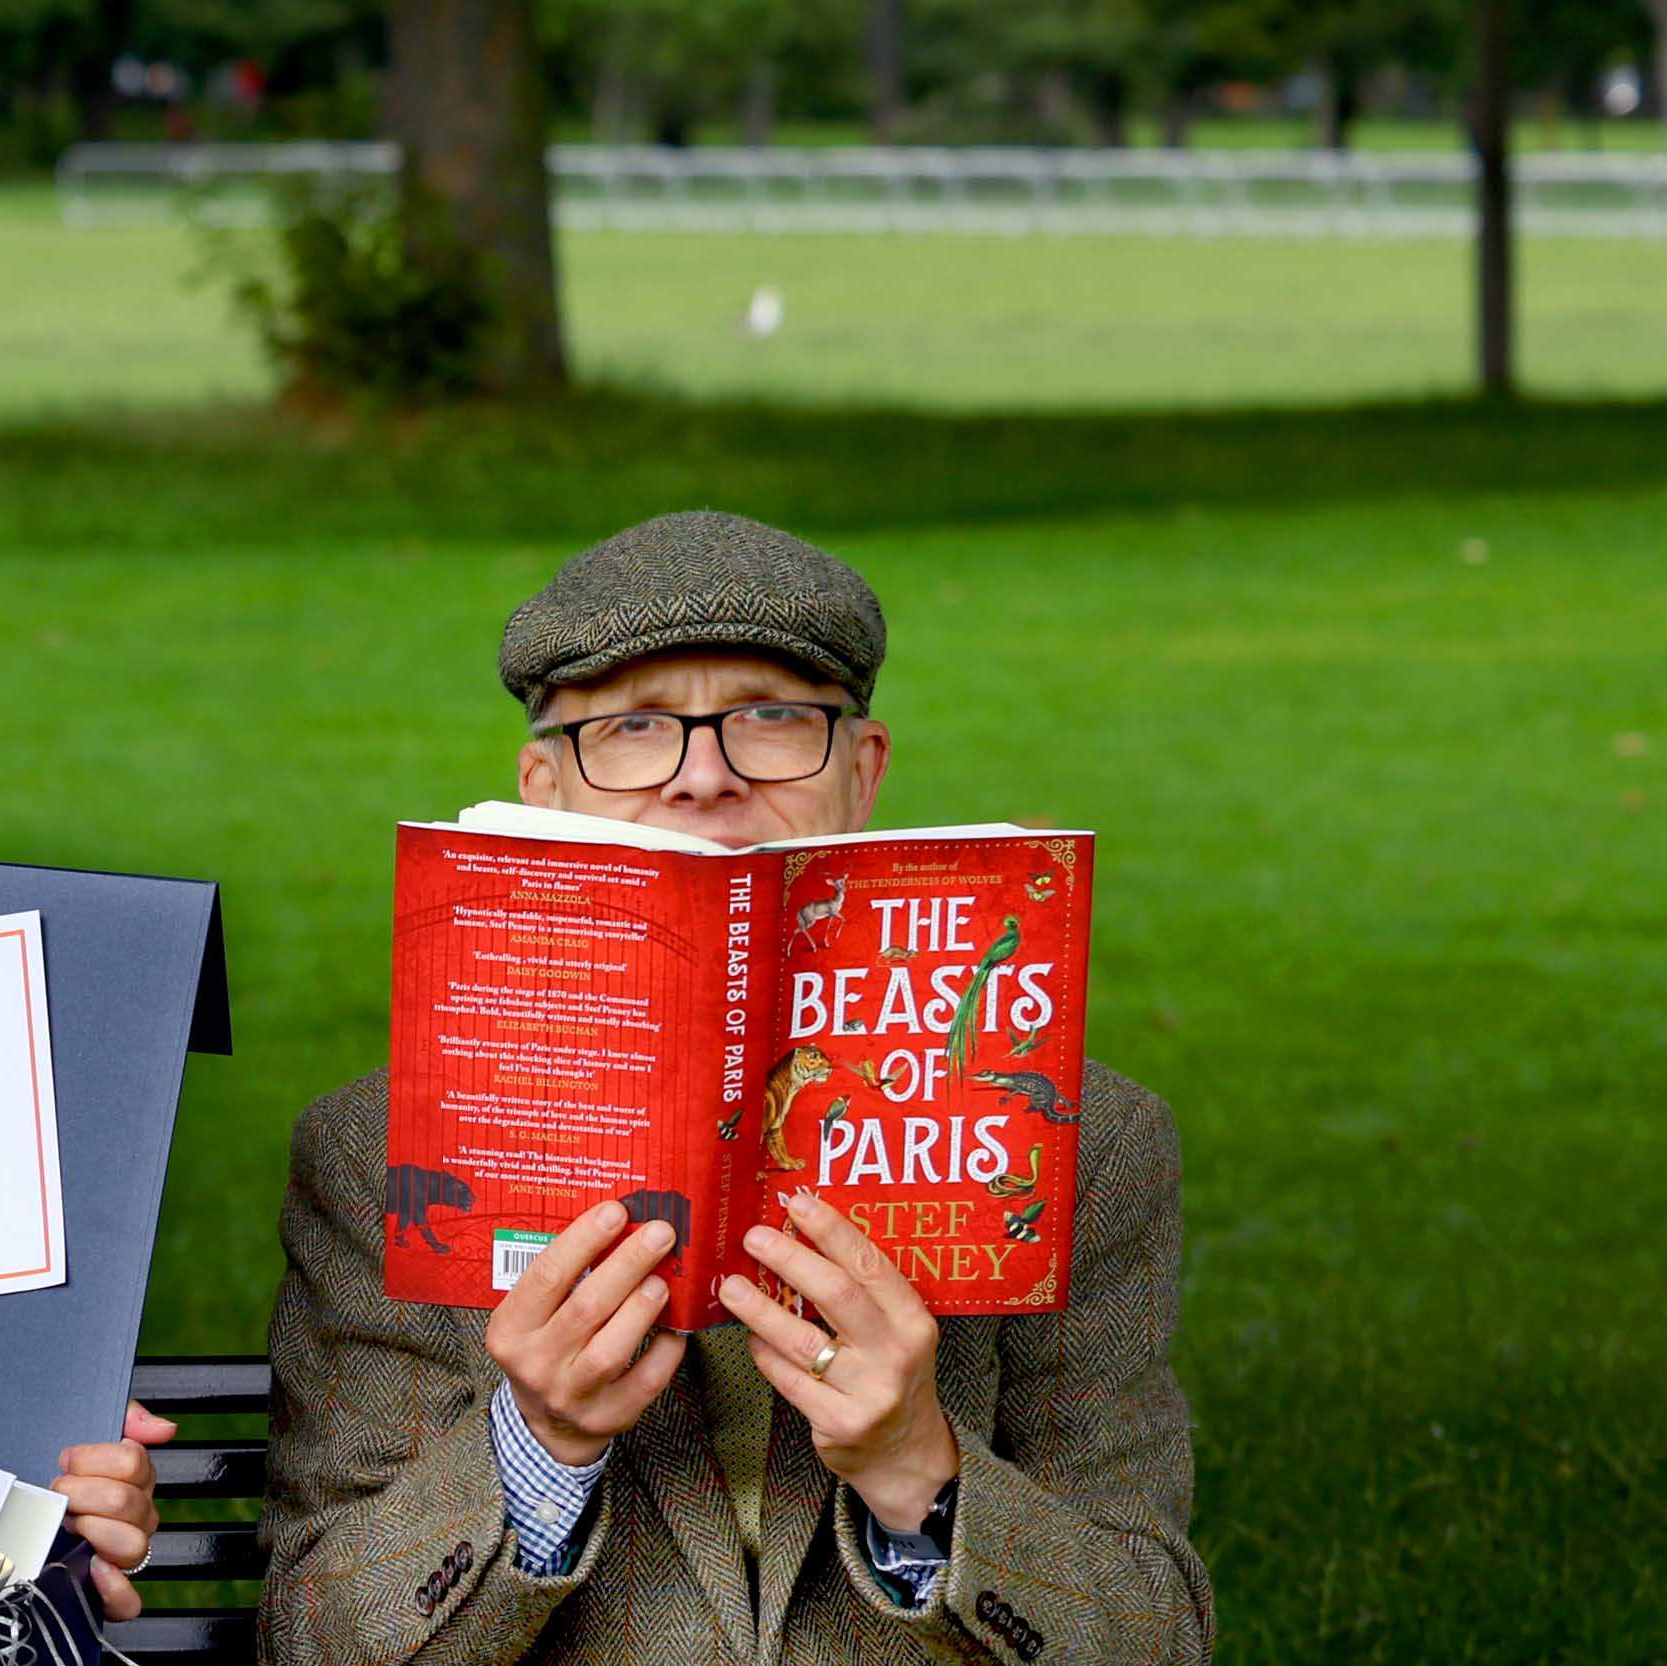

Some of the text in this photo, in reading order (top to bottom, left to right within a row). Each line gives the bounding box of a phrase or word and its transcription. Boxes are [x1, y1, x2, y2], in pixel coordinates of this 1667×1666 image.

[848, 874, 1004, 890] THE TENDERNESS OF WOLVES
[893, 861, 959, 874] By the author of
[870, 896, 976, 954] THE
[722, 873, 752, 1103] THE BEASTS OF PARIS
[788, 964, 1055, 1039] BEASTS
[879, 1048, 953, 1103] OF
[816, 1116, 1010, 1187] PARIS
[513, 1232, 548, 1243] QUERCUS
[849, 1200, 975, 1239] STEF
